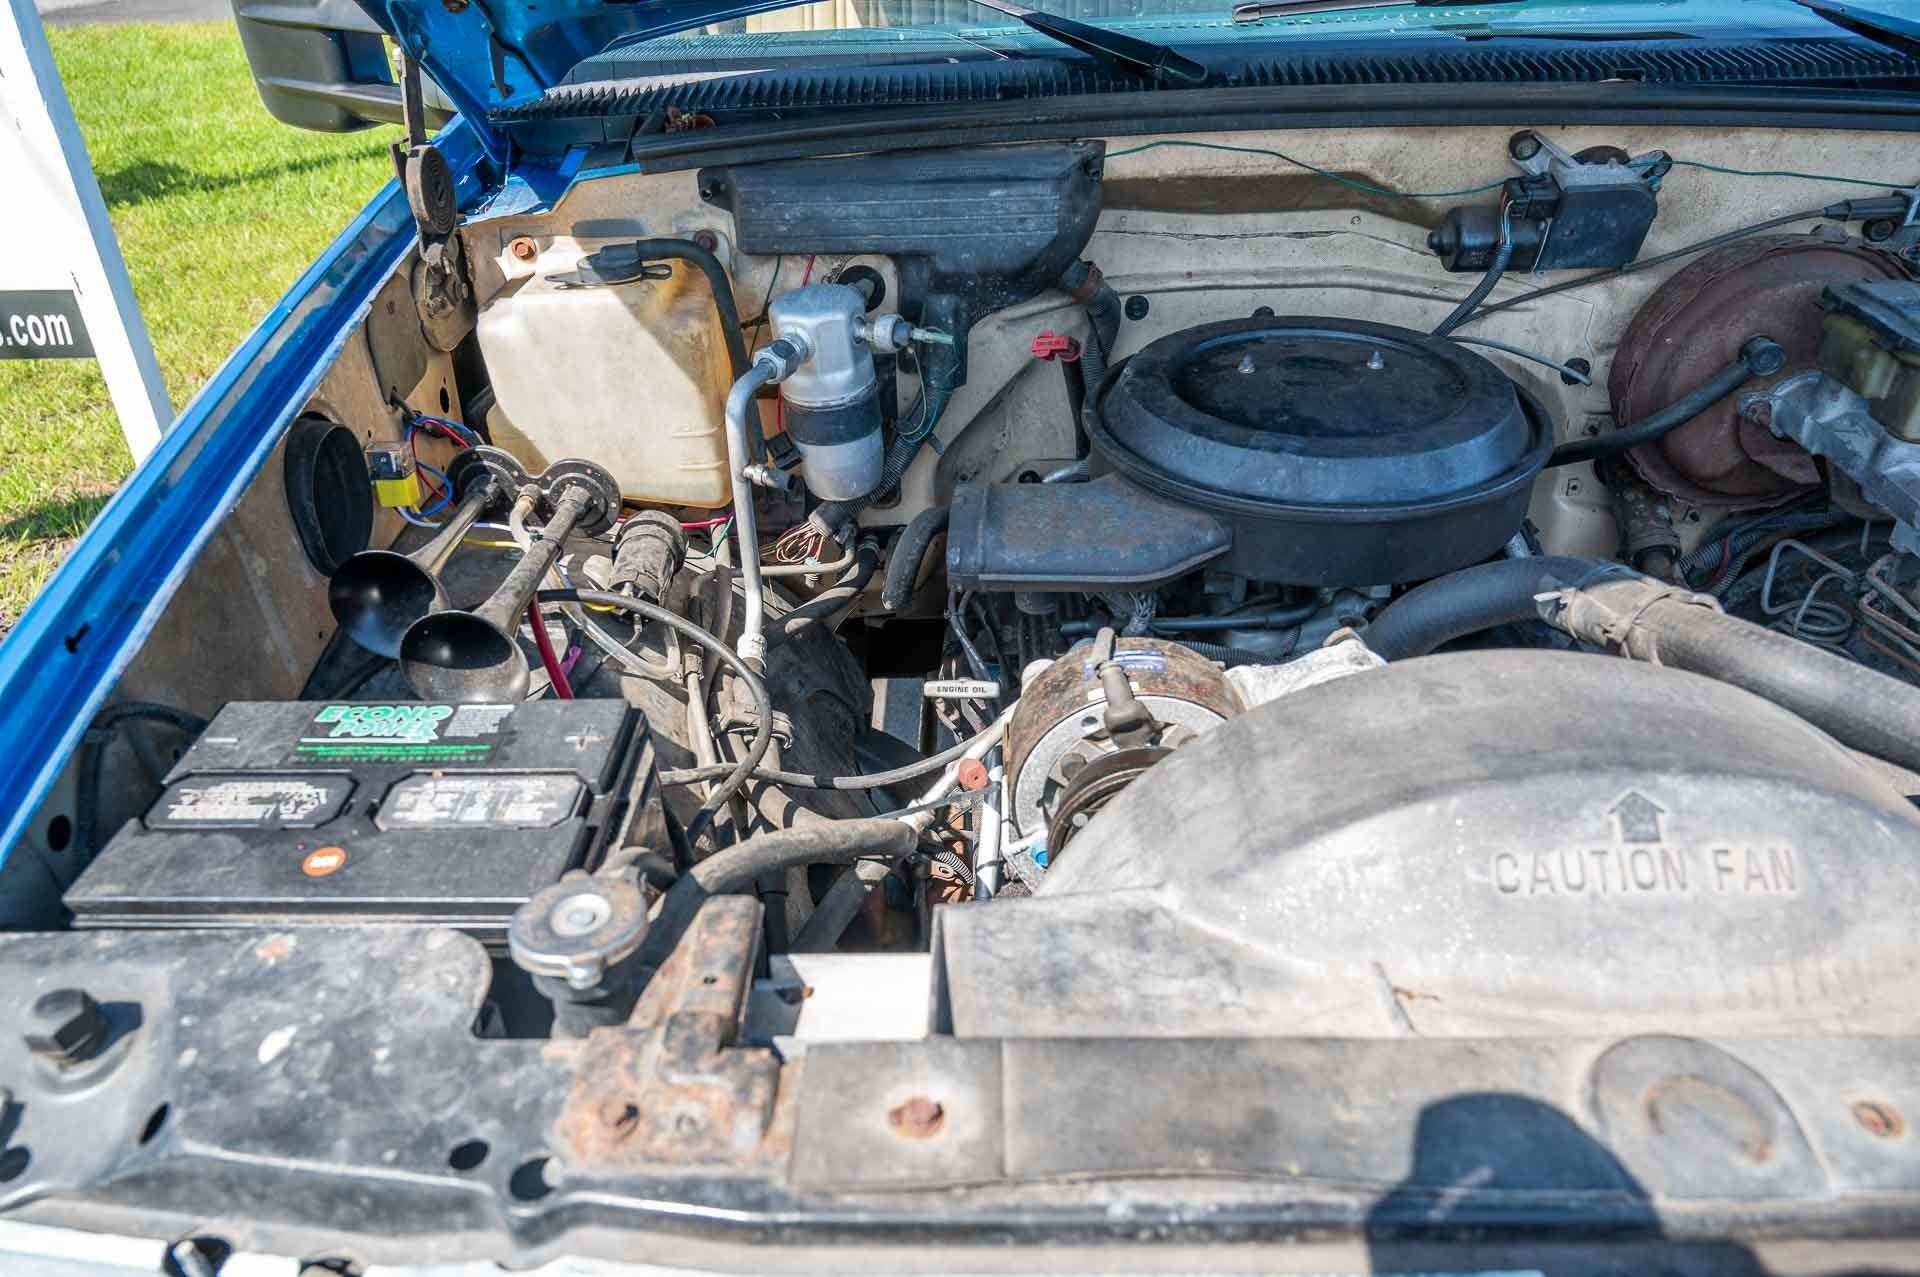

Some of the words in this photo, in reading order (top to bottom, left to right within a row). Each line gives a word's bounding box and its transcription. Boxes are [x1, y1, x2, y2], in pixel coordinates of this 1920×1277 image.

[0, 313, 74, 347] .com
[936, 685, 969, 694] ENGINE
[972, 686, 987, 694] OIL
[313, 705, 454, 723] ECONO
[328, 720, 439, 741] POWER
[1494, 847, 1688, 895] CAUTION
[1713, 846, 1798, 893] FAN
